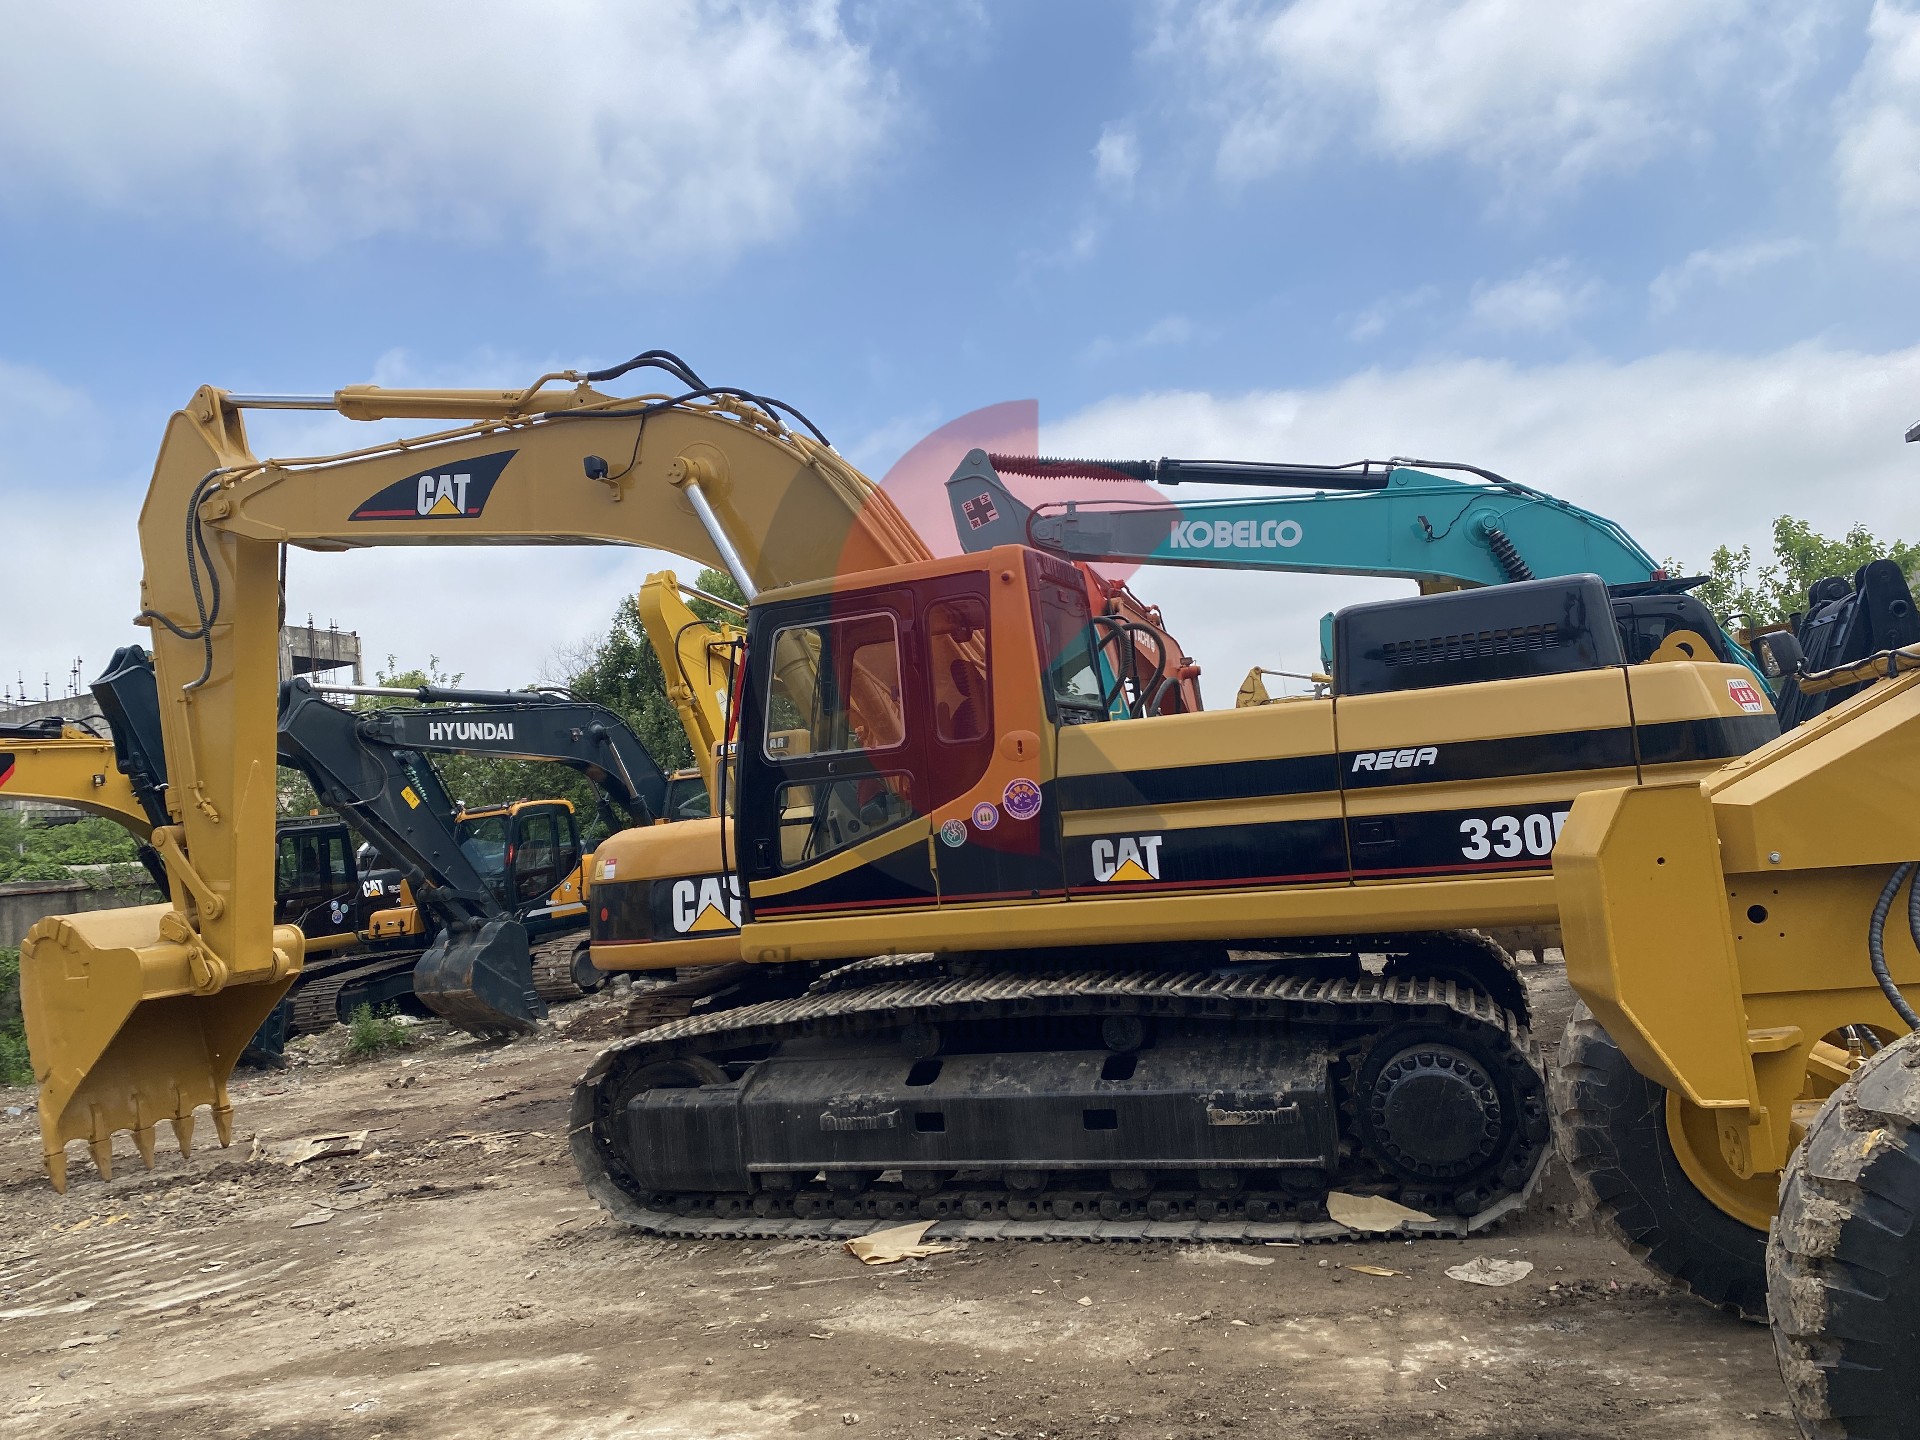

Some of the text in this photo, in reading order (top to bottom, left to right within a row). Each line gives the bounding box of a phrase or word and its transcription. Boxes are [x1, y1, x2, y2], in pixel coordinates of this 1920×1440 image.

[417, 474, 471, 516] CAT
[1170, 520, 1303, 548] KOBELCO
[429, 722, 514, 740] HYUNDAI
[1351, 746, 1438, 773] REGA
[1091, 835, 1163, 882] CAT
[362, 879, 384, 898] CAT
